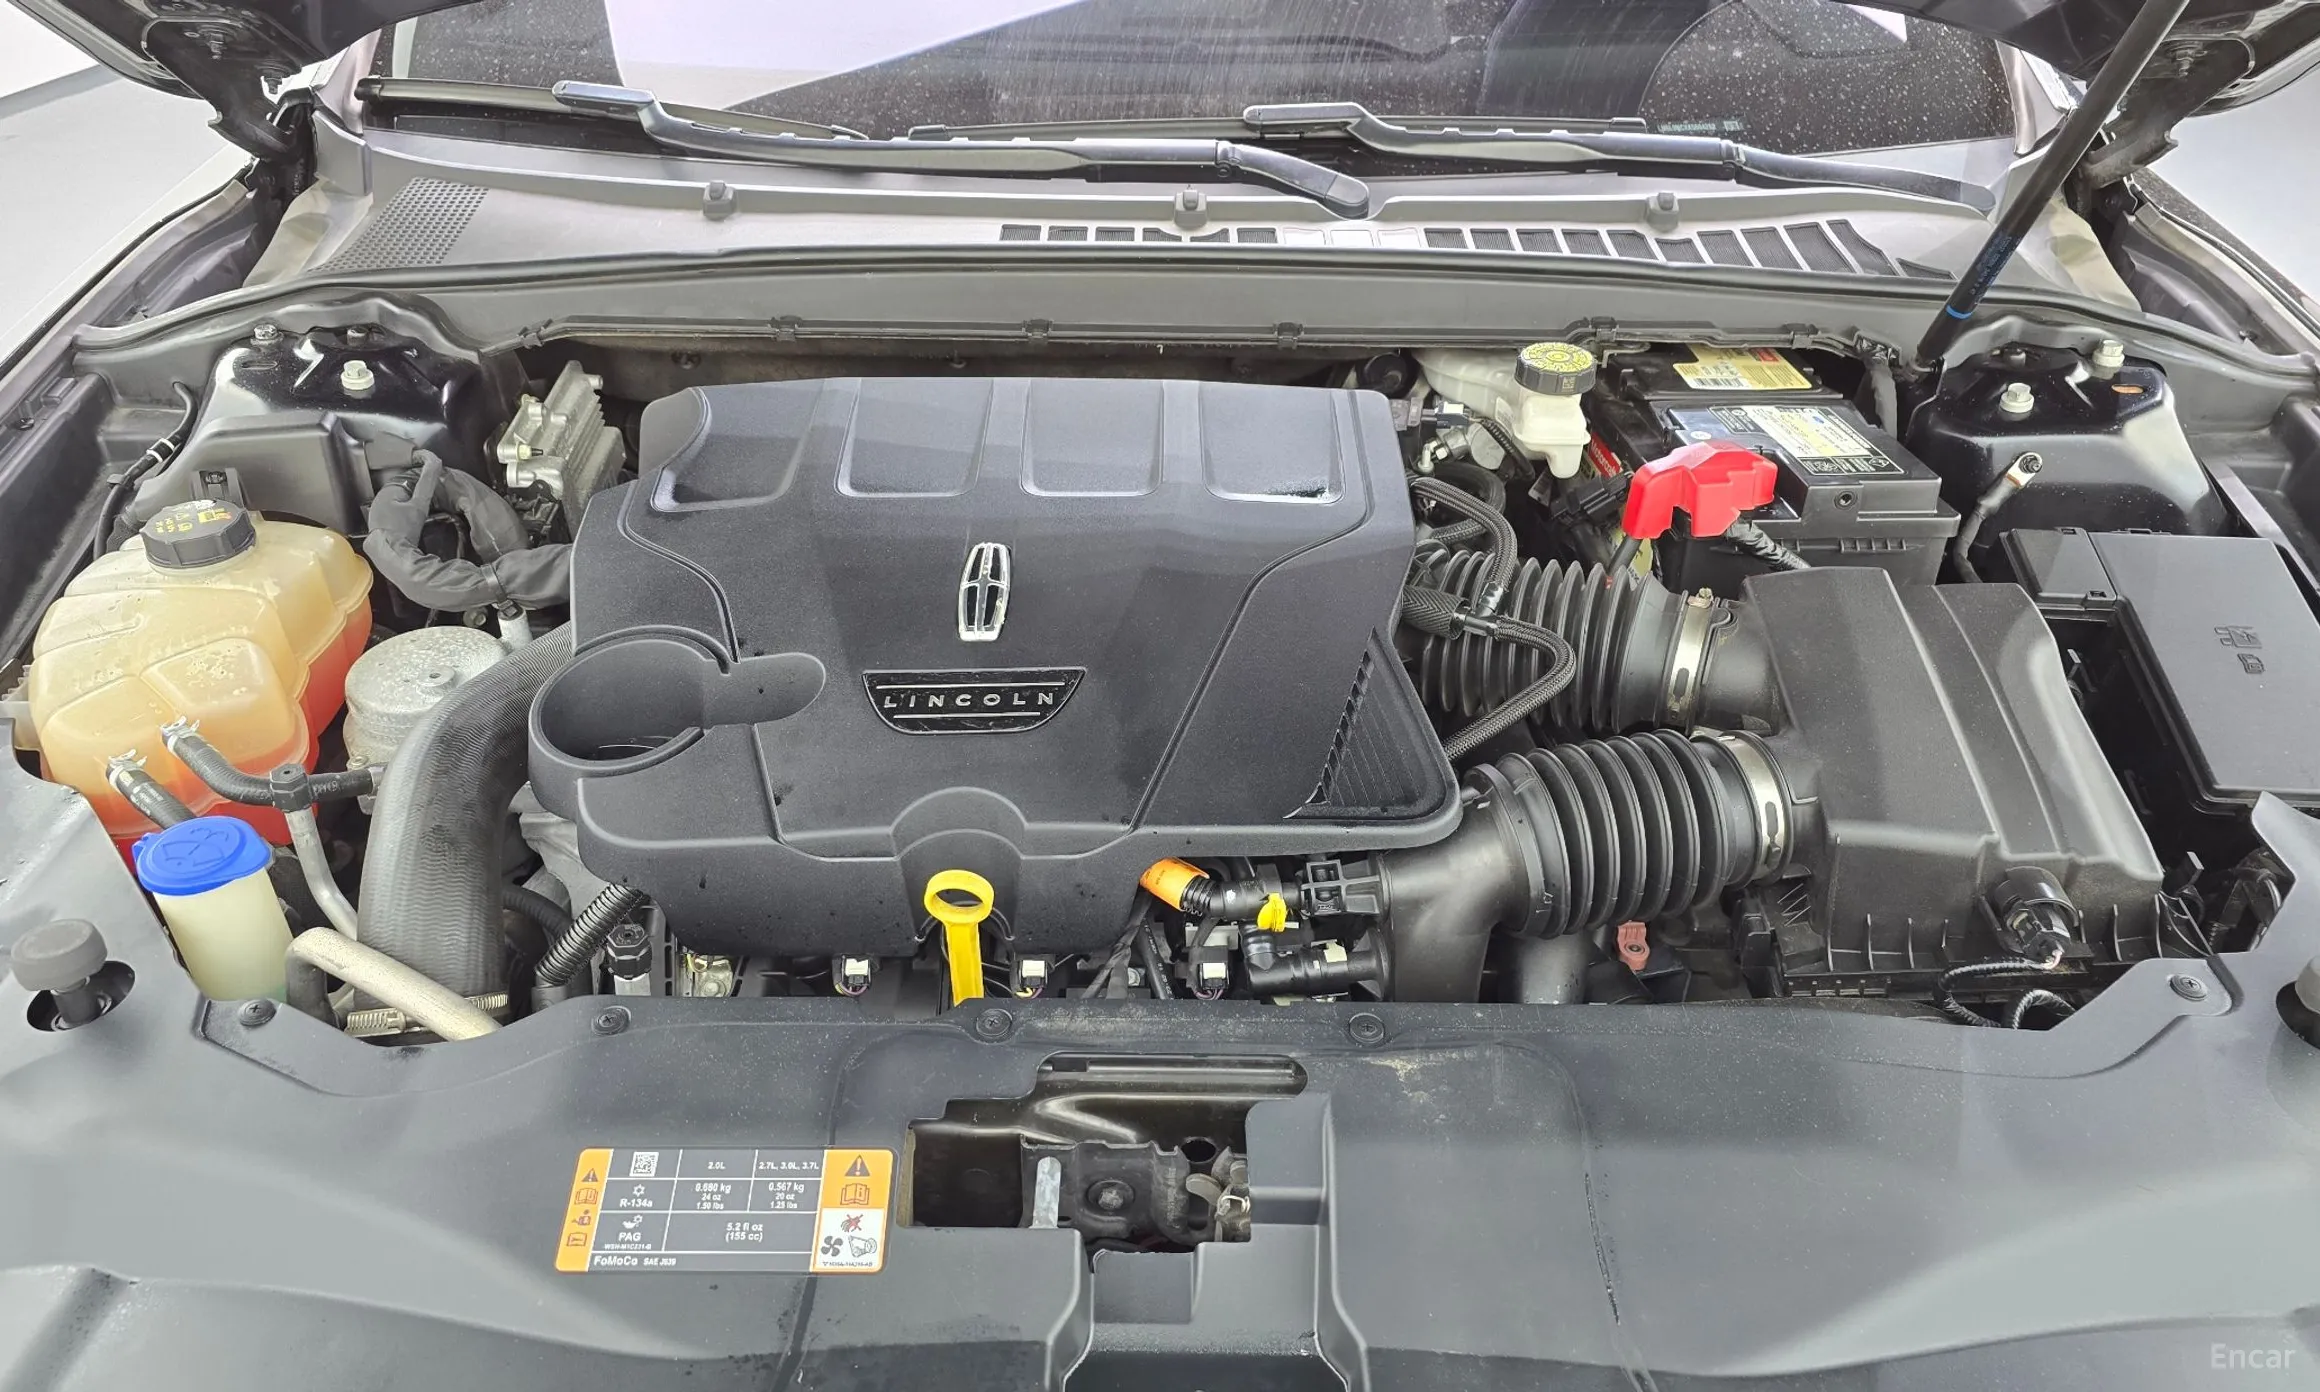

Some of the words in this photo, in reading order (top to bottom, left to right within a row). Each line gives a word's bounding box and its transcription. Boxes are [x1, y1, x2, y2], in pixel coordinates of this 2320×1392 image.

[884, 692, 1053, 708] LINCOLN
[707, 1161, 726, 1170] 2.0L
[759, 1161, 778, 1171] 2.7L,
[802, 1161, 819, 1170] 3.7L
[720, 1183, 731, 1194] kg
[768, 1182, 791, 1192] 0.567
[793, 1182, 805, 1193] kg
[619, 1198, 653, 1208] R-134a
[726, 1222, 741, 1231] 5.2
[618, 1232, 641, 1242] PAG
[725, 1231, 746, 1243] (155
[748, 1232, 763, 1243] cc)
[593, 1255, 638, 1266] FoMoCo
[643, 1258, 658, 1266] SAE
